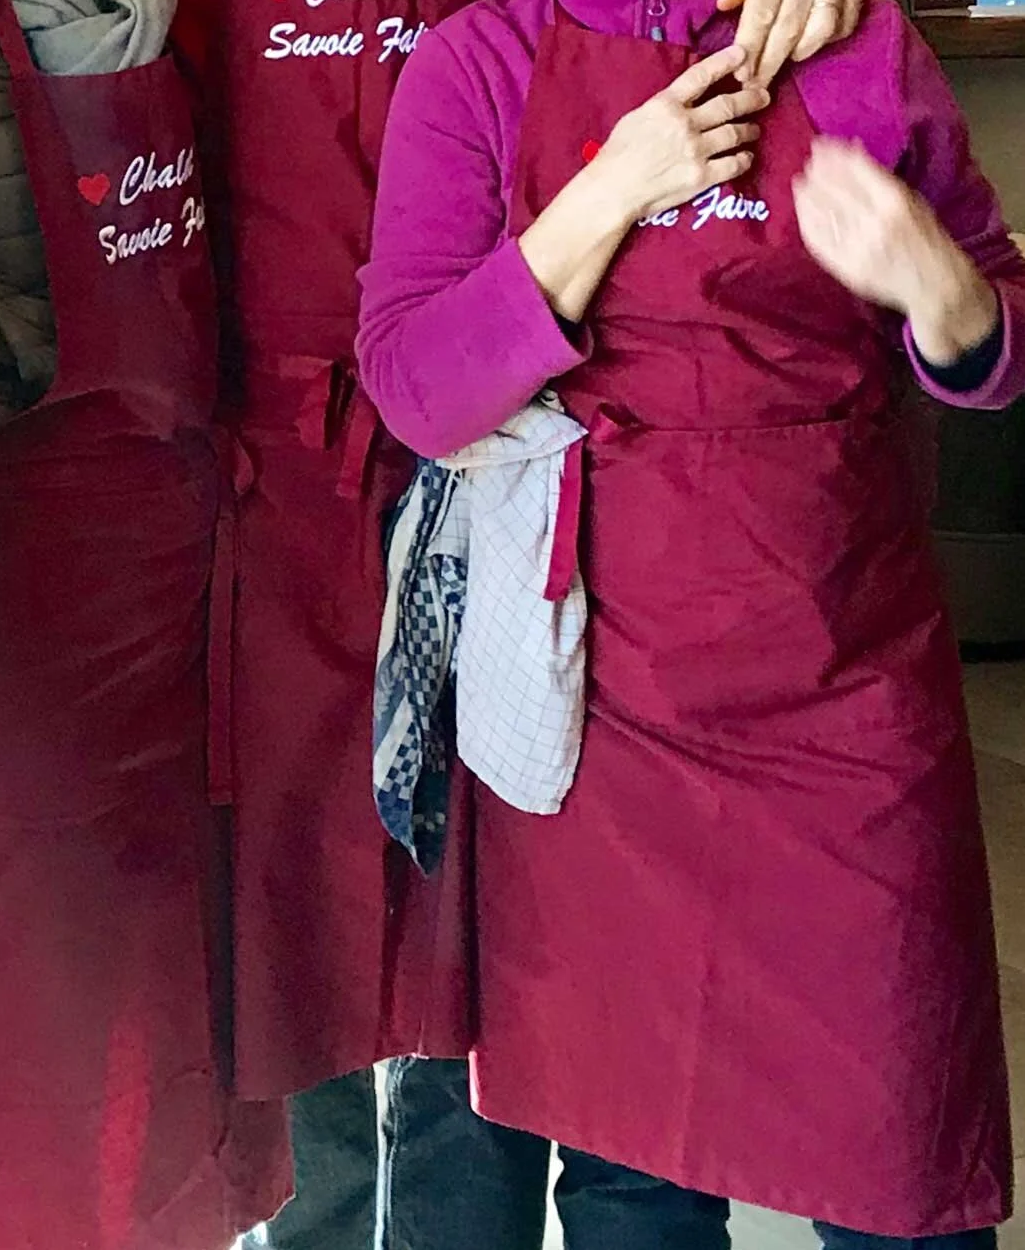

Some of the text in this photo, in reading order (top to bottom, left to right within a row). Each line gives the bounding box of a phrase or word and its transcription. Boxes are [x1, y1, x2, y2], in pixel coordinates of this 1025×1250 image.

[264, 16, 429, 63] Savoie Fai
[692, 186, 770, 231] Faire
[98, 218, 173, 265] Savoie
